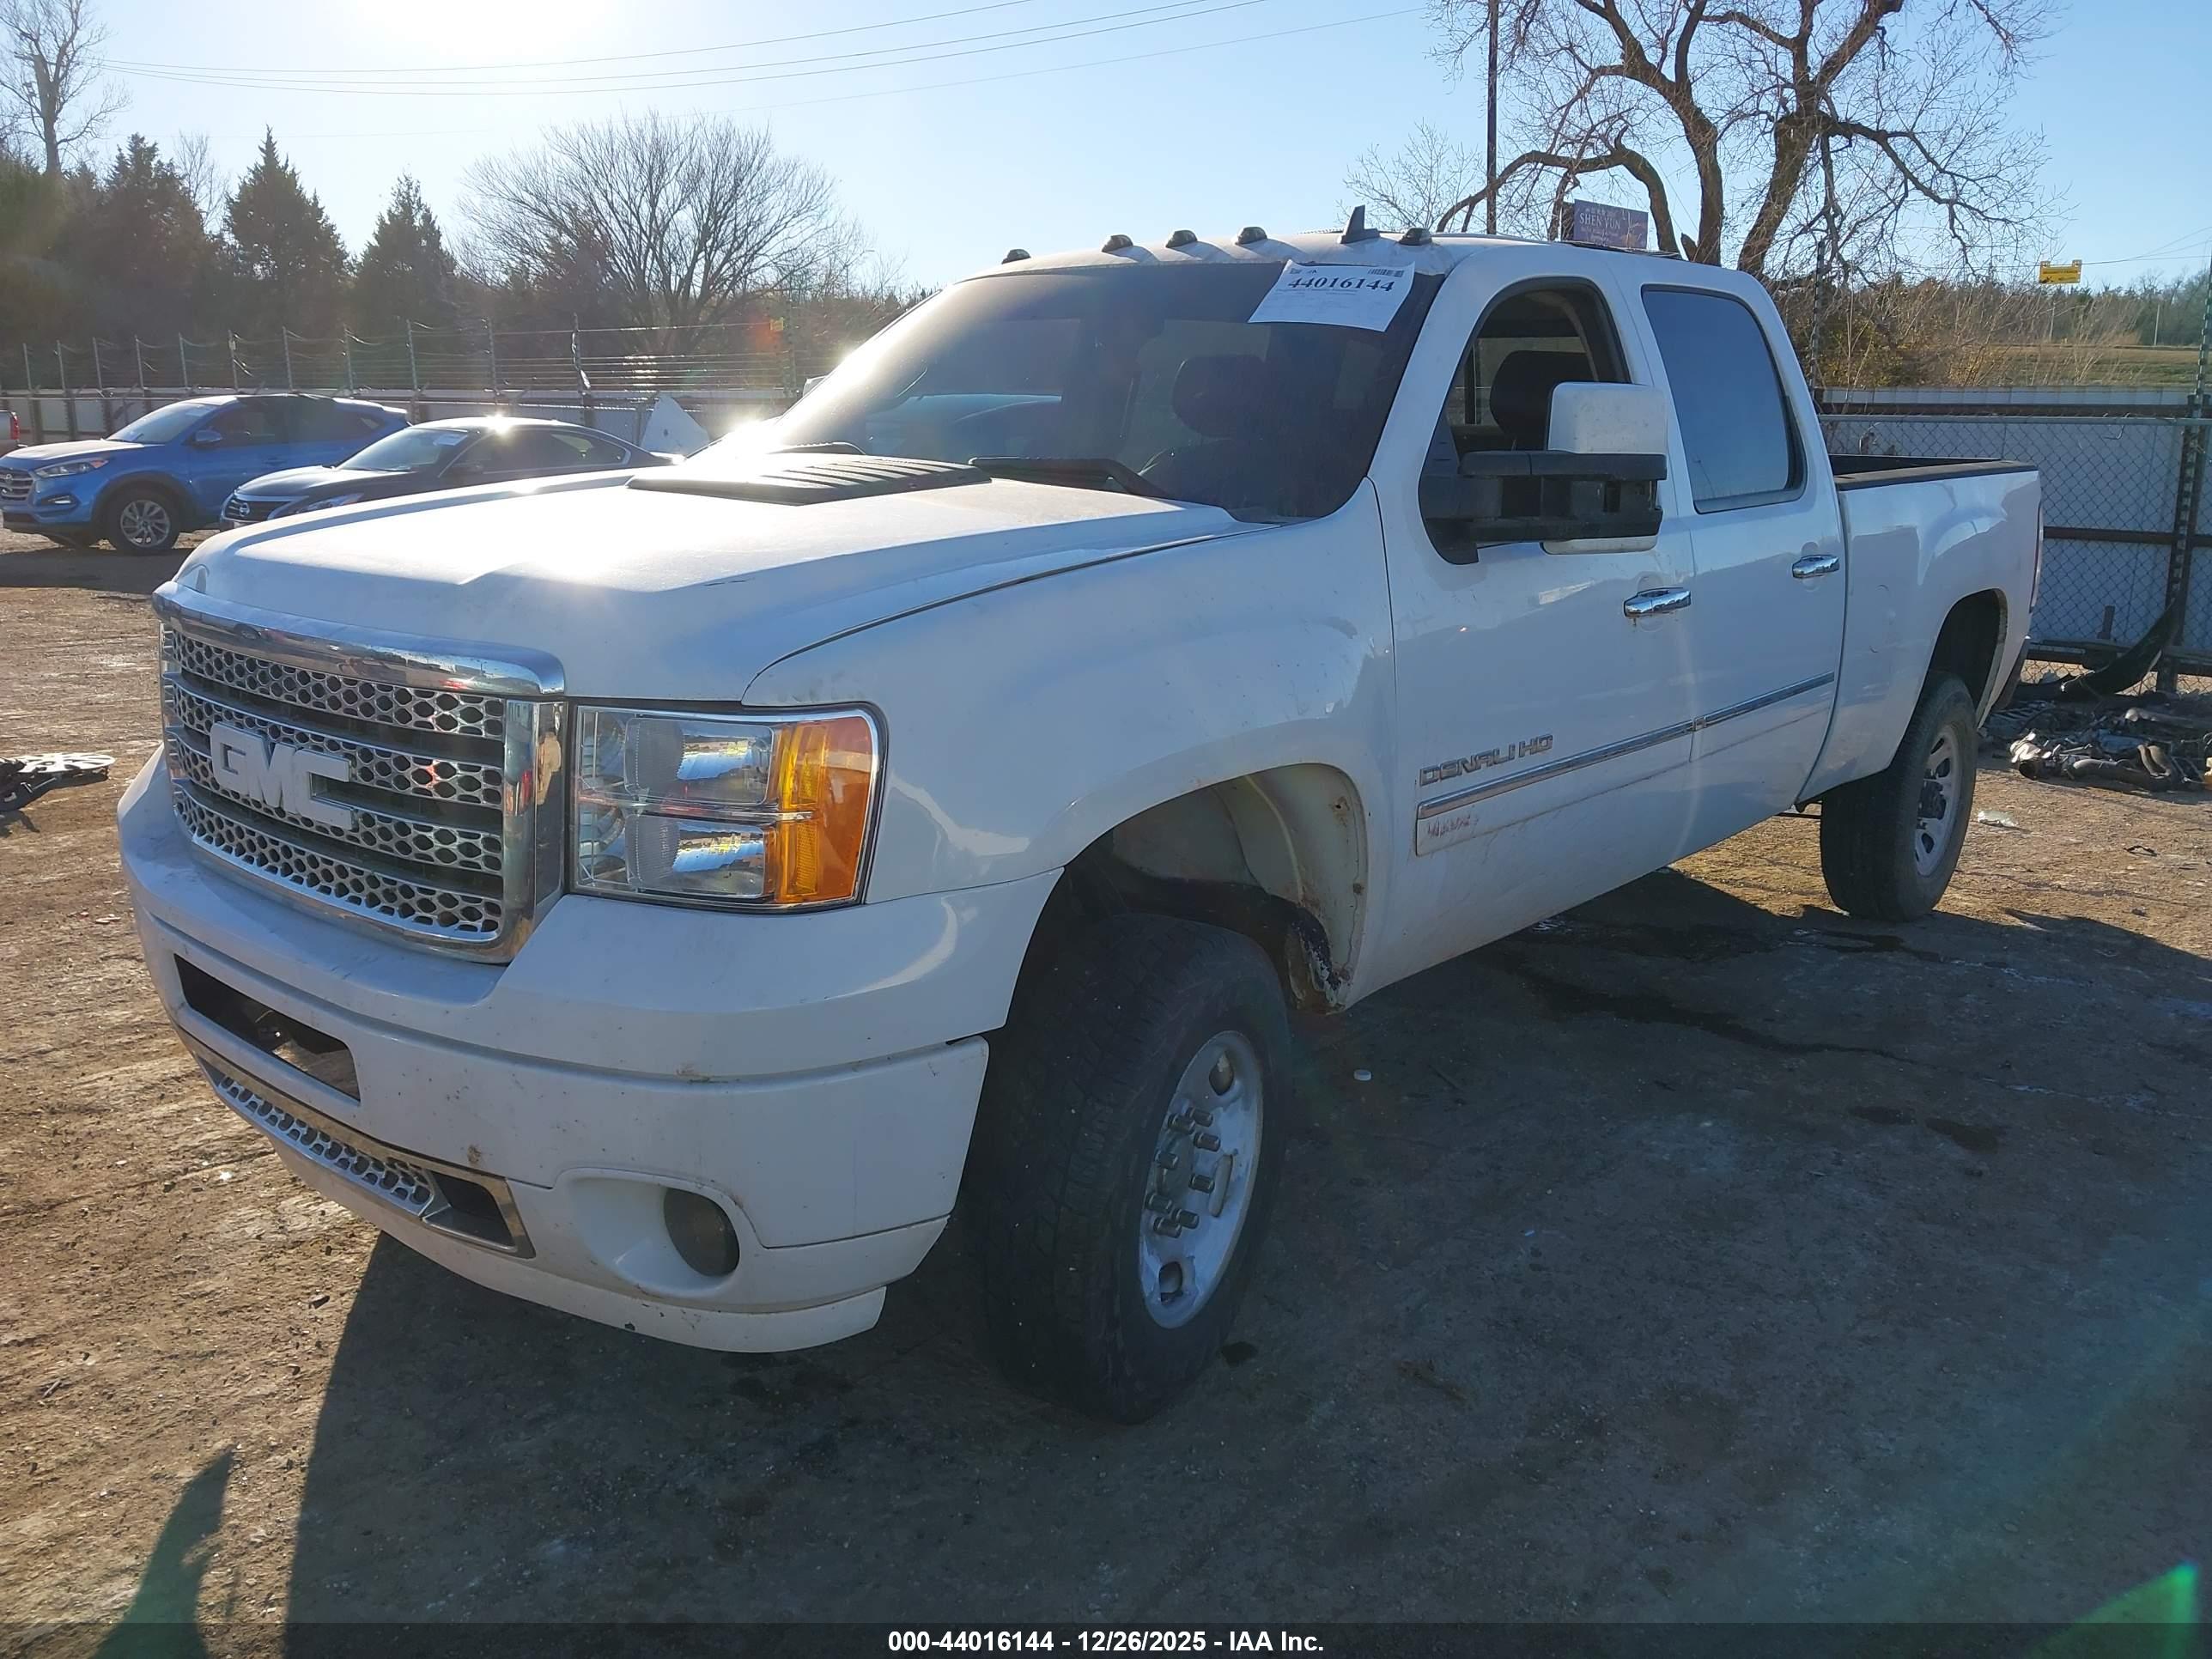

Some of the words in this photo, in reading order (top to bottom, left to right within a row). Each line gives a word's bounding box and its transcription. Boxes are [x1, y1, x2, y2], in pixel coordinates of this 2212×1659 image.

[1579, 212, 1602, 227] SHEN
[1288, 276, 1395, 292] 44016144
[210, 721, 356, 830] GMC
[1419, 744, 1516, 786] DENALI
[1518, 734, 1553, 757] HD
